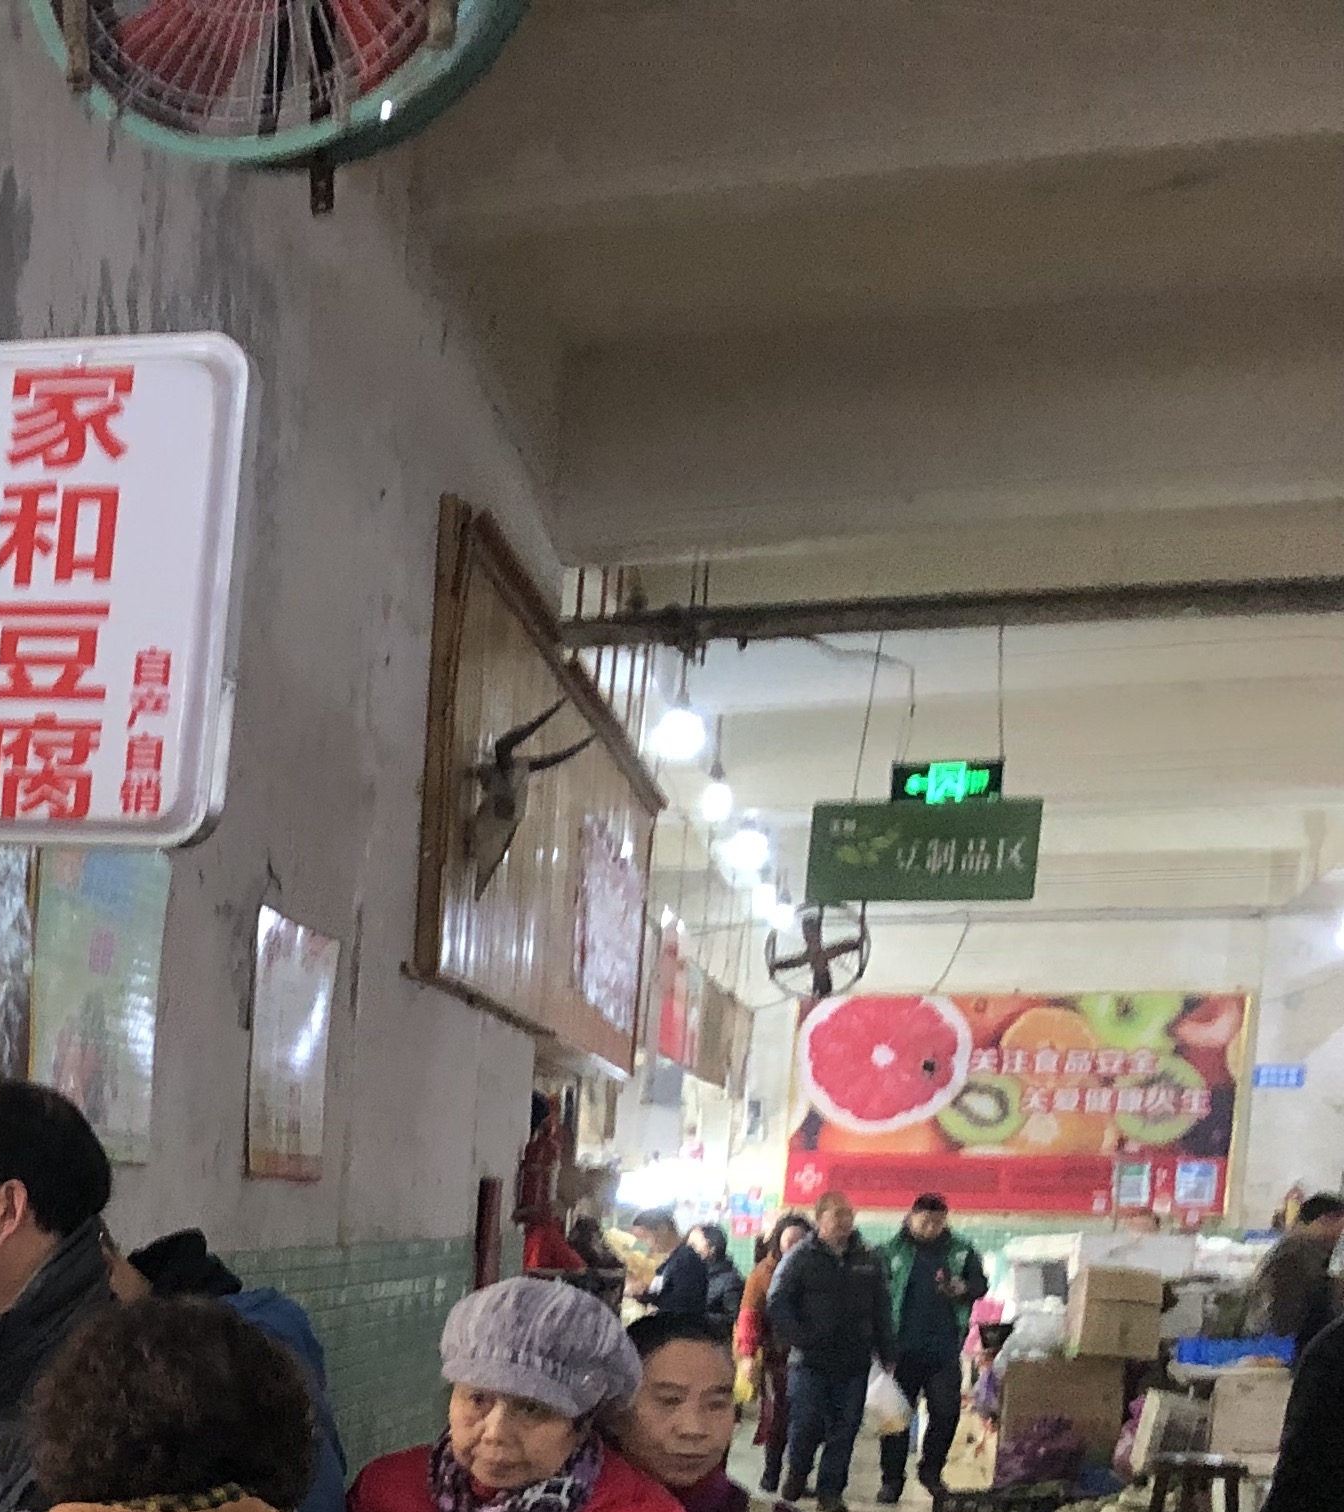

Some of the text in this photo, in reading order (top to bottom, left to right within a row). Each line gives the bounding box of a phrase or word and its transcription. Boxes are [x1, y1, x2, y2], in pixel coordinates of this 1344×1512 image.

[119, 645, 173, 818] 自产自销
[969, 1047, 1159, 1075] 关注食品安全
